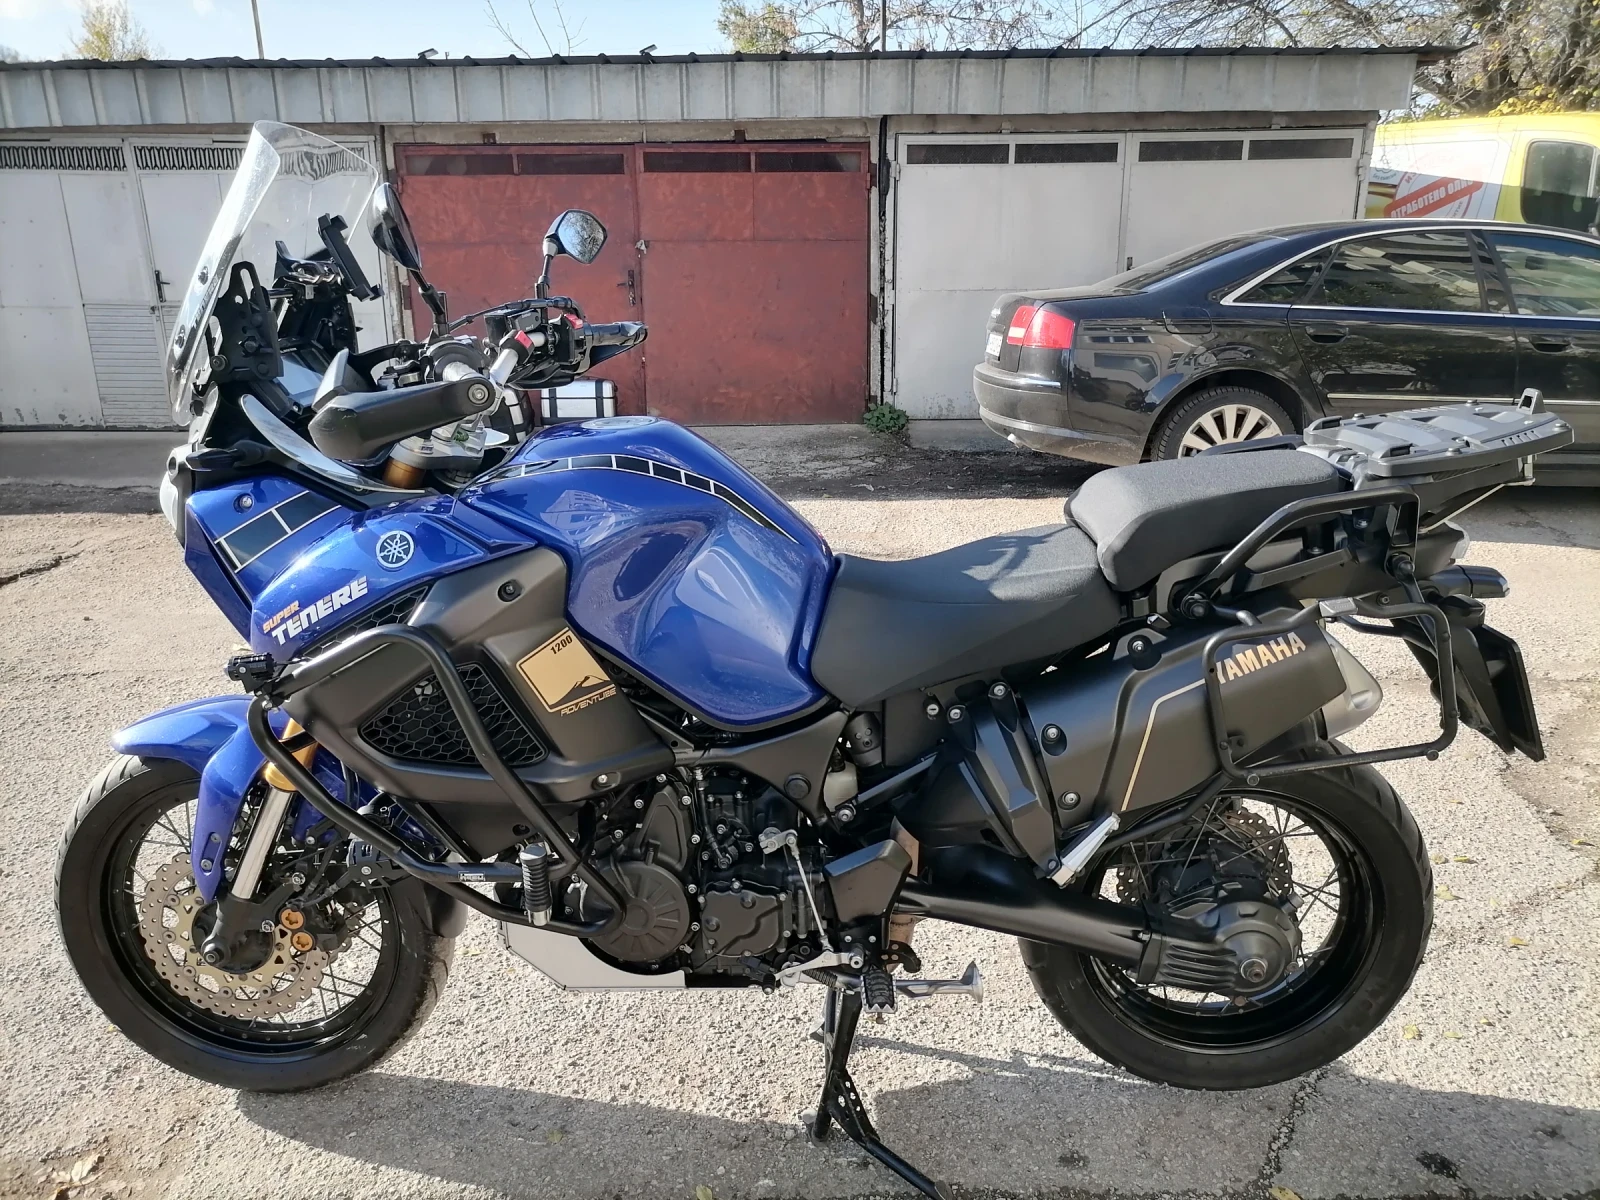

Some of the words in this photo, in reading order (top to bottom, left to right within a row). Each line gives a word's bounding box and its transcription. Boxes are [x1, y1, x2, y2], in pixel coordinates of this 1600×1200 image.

[262, 600, 300, 634] SUPER
[271, 575, 368, 646] TENERE
[550, 634, 573, 655] 1200
[1215, 631, 1307, 685] YAMAHA
[560, 687, 617, 717] ADVENTURE
